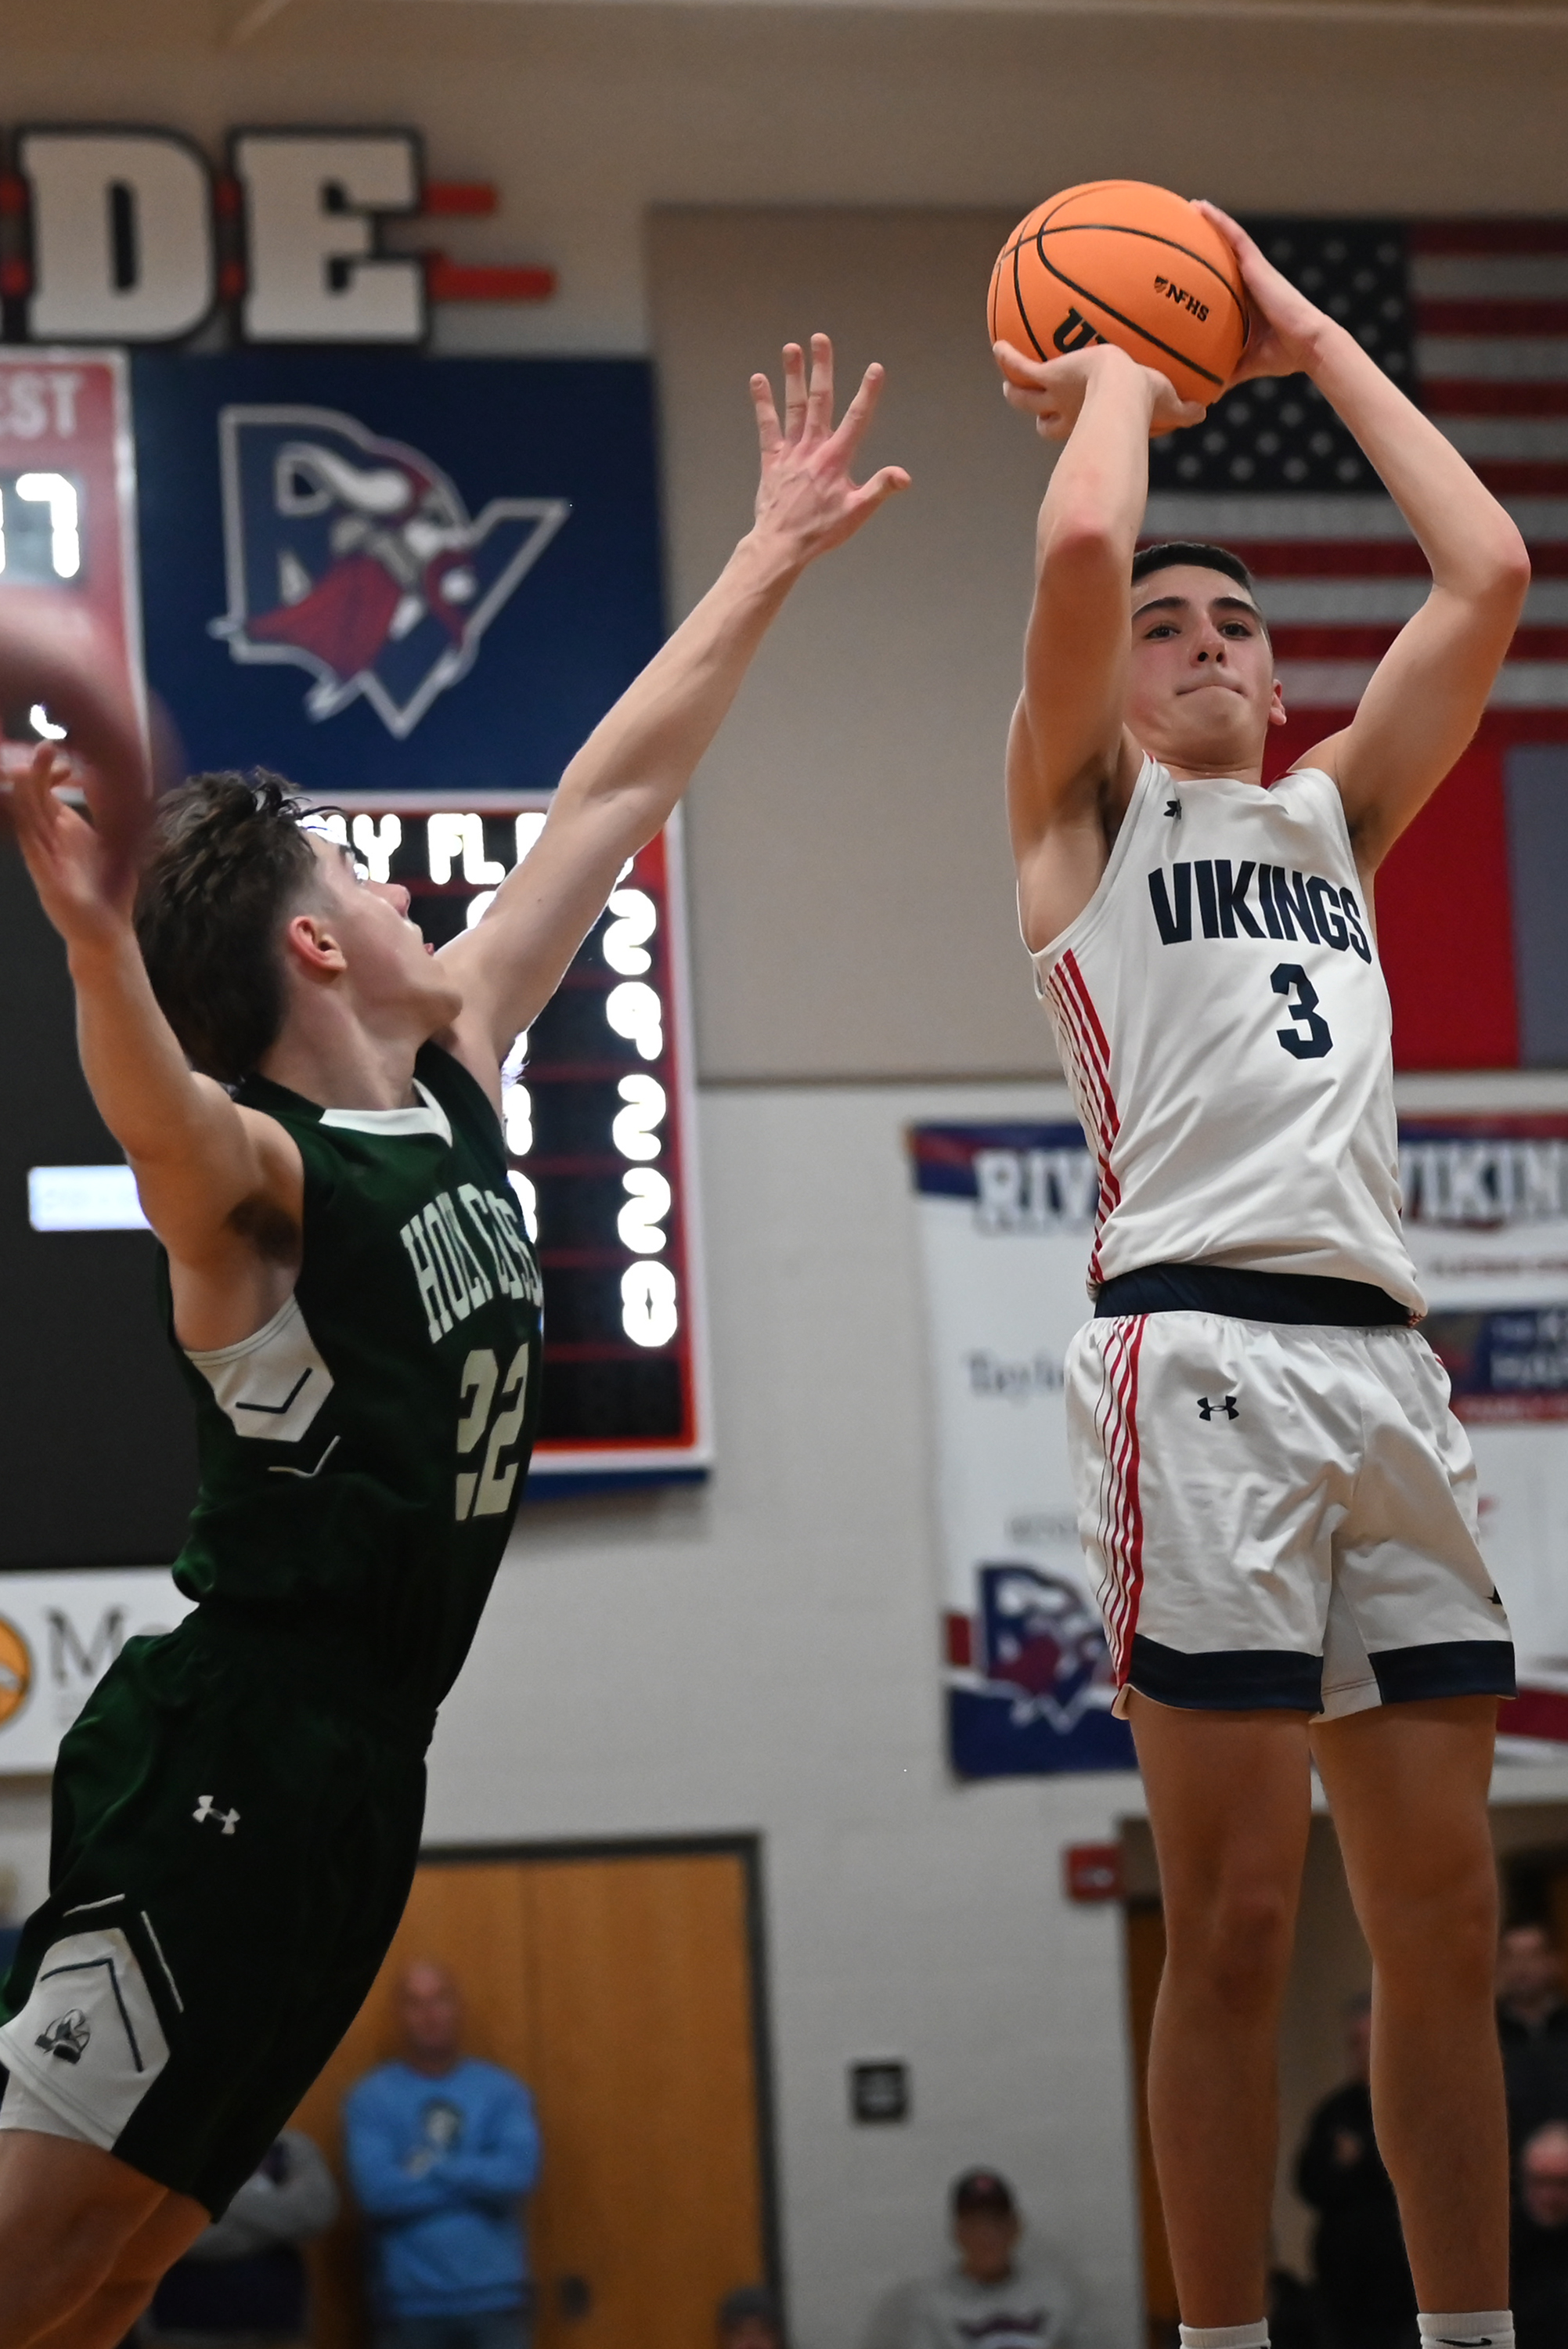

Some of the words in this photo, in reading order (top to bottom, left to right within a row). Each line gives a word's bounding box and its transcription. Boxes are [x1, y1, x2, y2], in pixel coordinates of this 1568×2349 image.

[1166, 283, 1209, 322] NFHS
[0, 370, 81, 439] ST
[0, 472, 81, 579] 7
[427, 813, 506, 885] FL
[603, 888, 658, 976] 2
[1148, 859, 1372, 965] VIKINGS
[605, 981, 663, 1061] 9
[1270, 962, 1334, 1060] 3
[612, 1073, 667, 1161] 2
[617, 1167, 672, 1254] 2
[620, 1260, 678, 1348] 0
[455, 1341, 530, 1521] 22
